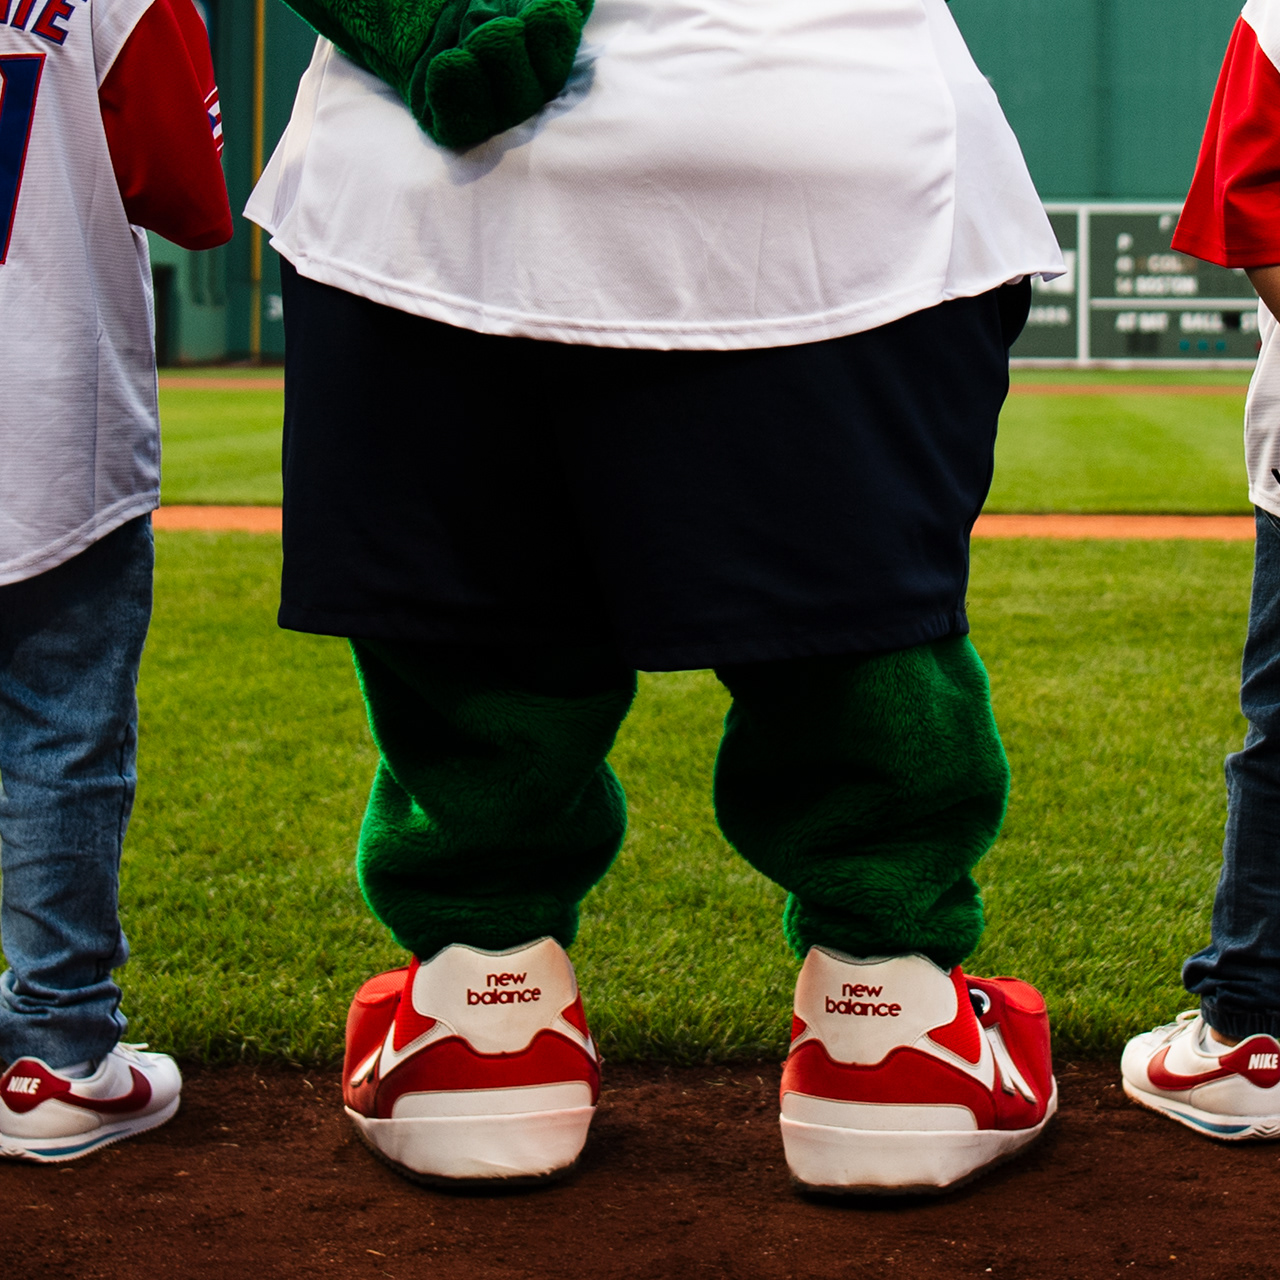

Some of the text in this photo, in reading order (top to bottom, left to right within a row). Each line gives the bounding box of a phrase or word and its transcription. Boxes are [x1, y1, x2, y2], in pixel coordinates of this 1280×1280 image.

[486, 971, 528, 987] new
[466, 985, 542, 1007] balance
[841, 982, 884, 998] new
[825, 996, 902, 1018] balance
[1248, 1052, 1280, 1071] NIKE
[6, 1075, 41, 1096] NIKE
